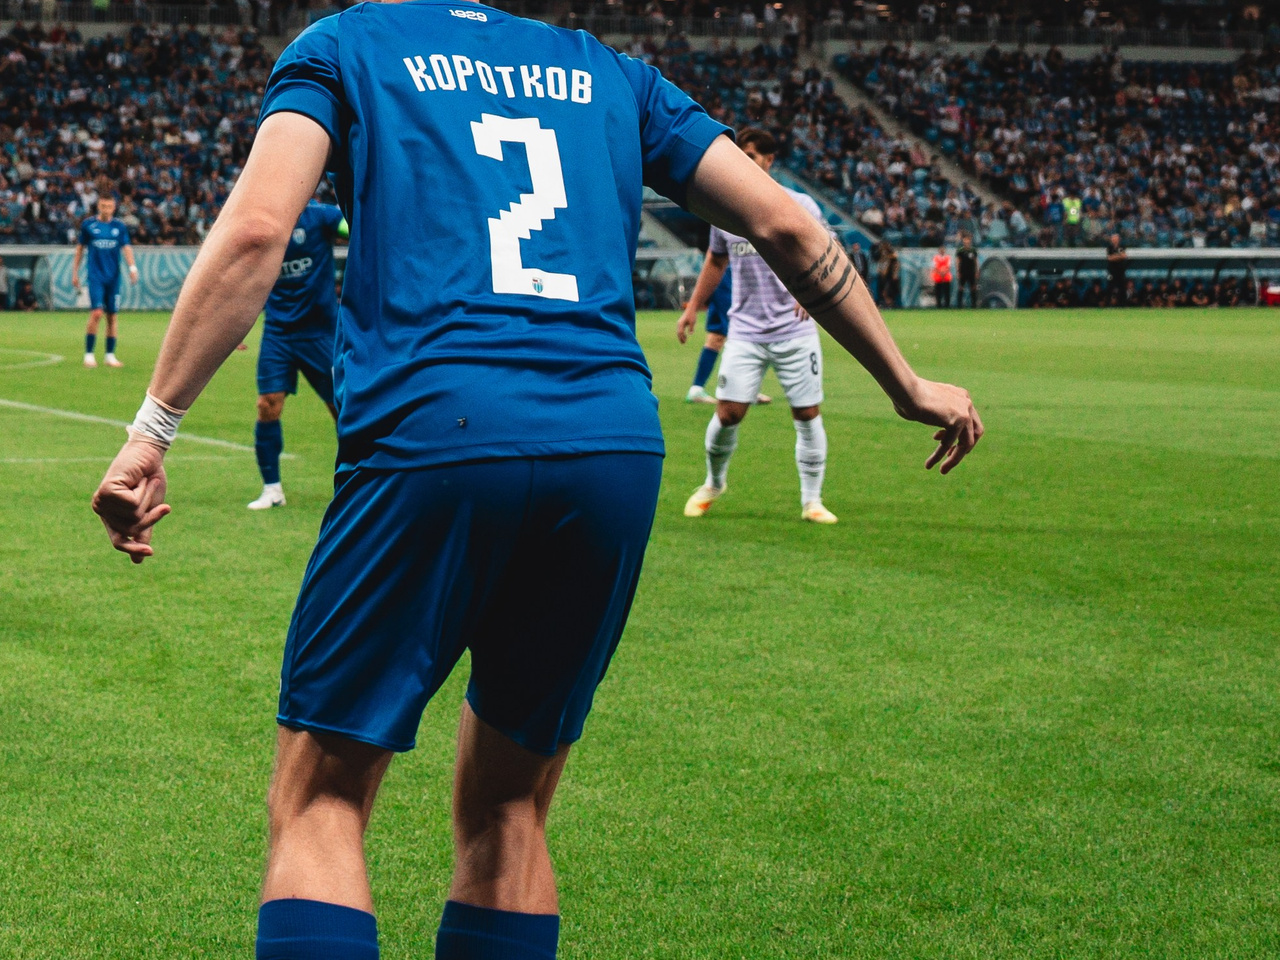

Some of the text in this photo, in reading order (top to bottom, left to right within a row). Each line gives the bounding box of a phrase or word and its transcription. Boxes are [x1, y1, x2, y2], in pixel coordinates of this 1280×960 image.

[449, 10, 487, 22] 1929
[403, 54, 592, 104] КОРОТКОВ
[470, 113, 579, 302] 2
[282, 257, 313, 274] ТОР
[809, 352, 818, 375] 8
